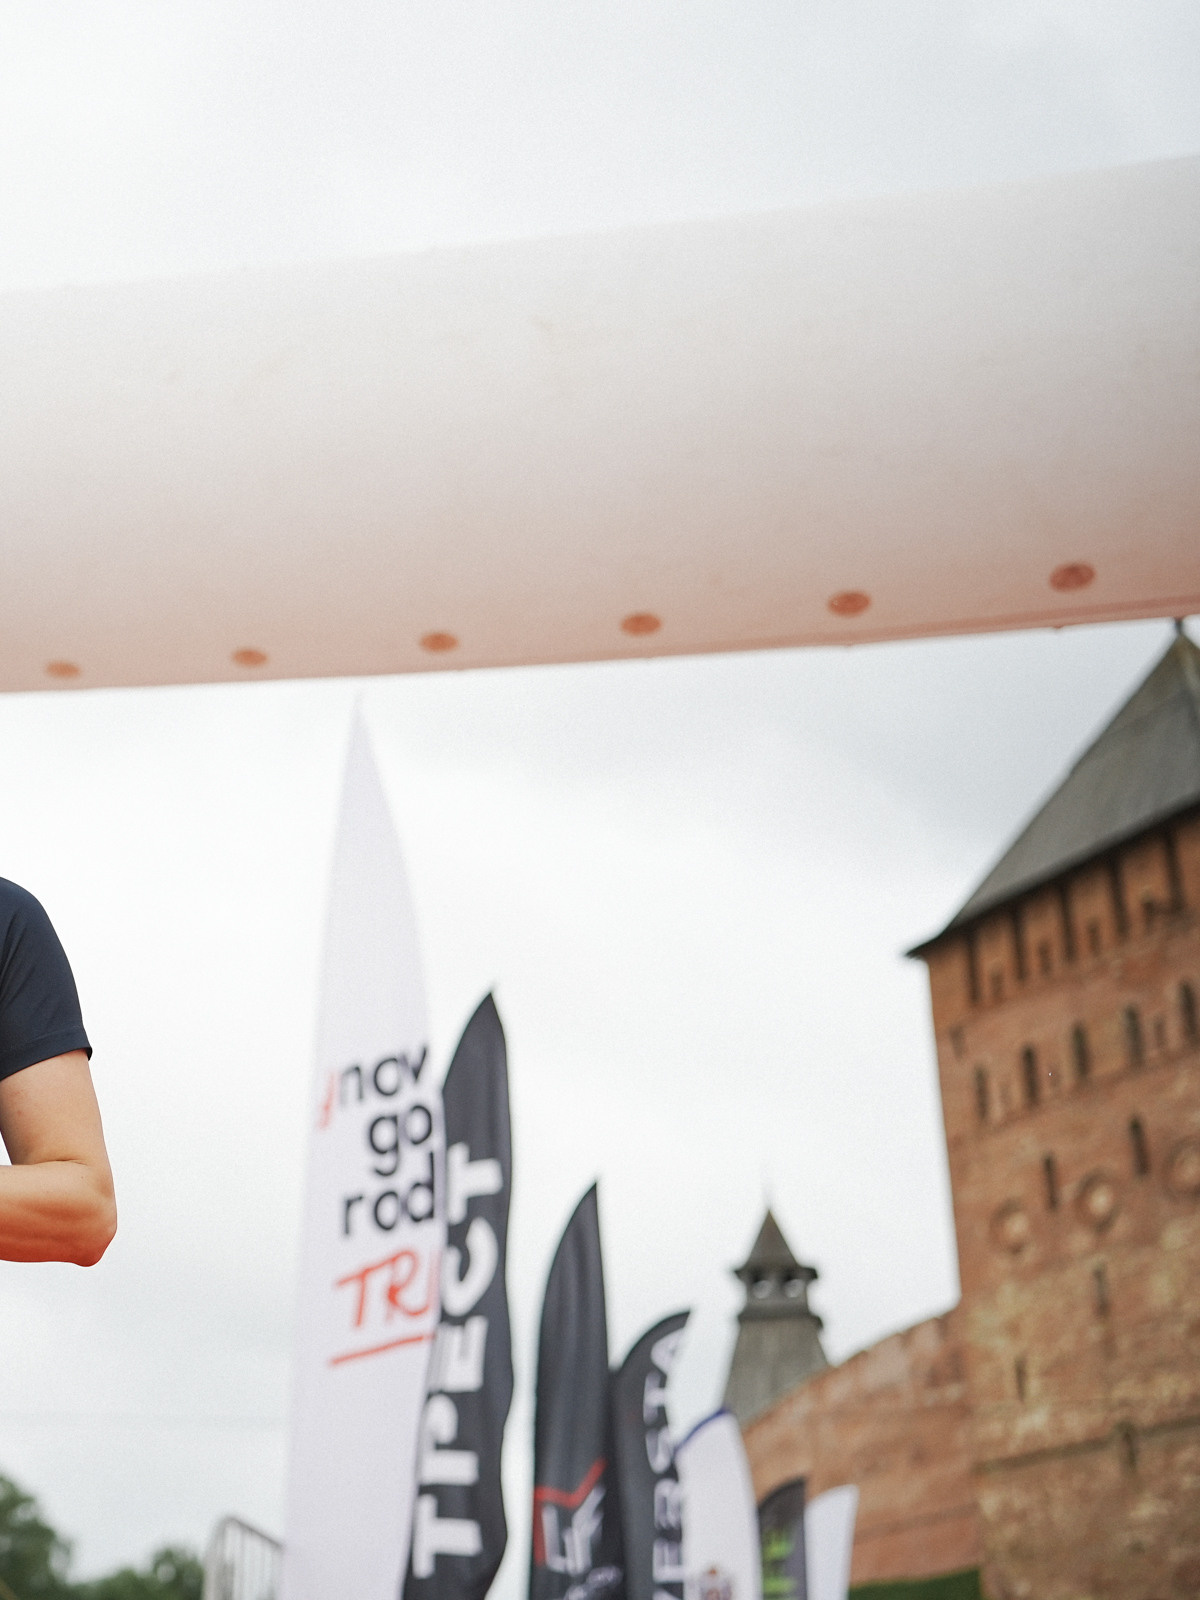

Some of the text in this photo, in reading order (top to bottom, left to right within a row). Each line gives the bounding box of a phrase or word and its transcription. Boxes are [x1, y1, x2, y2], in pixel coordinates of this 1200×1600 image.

[370, 1104, 433, 1177] go
[341, 1152, 434, 1235] rod
[643, 1327, 689, 1600] ERSTA
